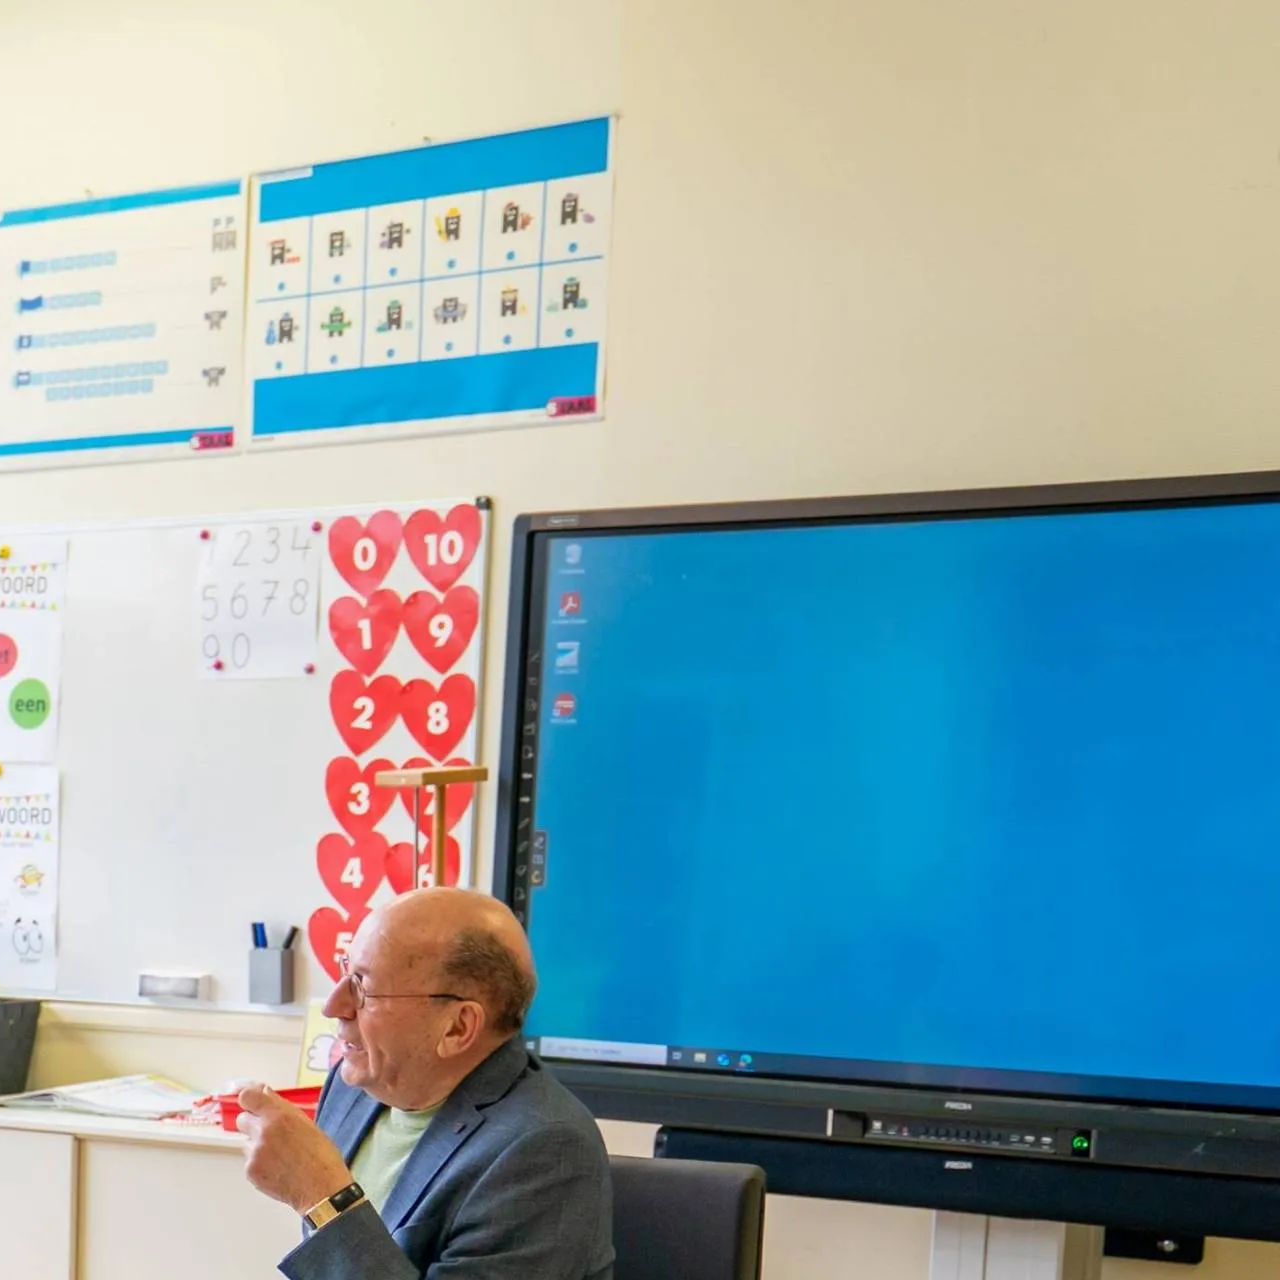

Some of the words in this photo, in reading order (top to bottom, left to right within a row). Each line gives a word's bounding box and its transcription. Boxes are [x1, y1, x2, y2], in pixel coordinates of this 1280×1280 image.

[232, 529, 252, 567] 2
[262, 526, 280, 564] 3
[291, 525, 312, 561] 4
[353, 537, 377, 571] 0
[424, 530, 464, 566] 10
[201, 584, 219, 621] 5
[230, 582, 249, 620] 6
[261, 579, 280, 617] 7
[289, 578, 310, 615] 8
[357, 618, 373, 650] 1
[428, 613, 454, 648] 9
[232, 632, 251, 670] 0
[15, 697, 46, 713] een
[350, 696, 375, 730] 2
[426, 700, 450, 735] 8
[347, 782, 370, 815] 3
[340, 857, 364, 888] 4
